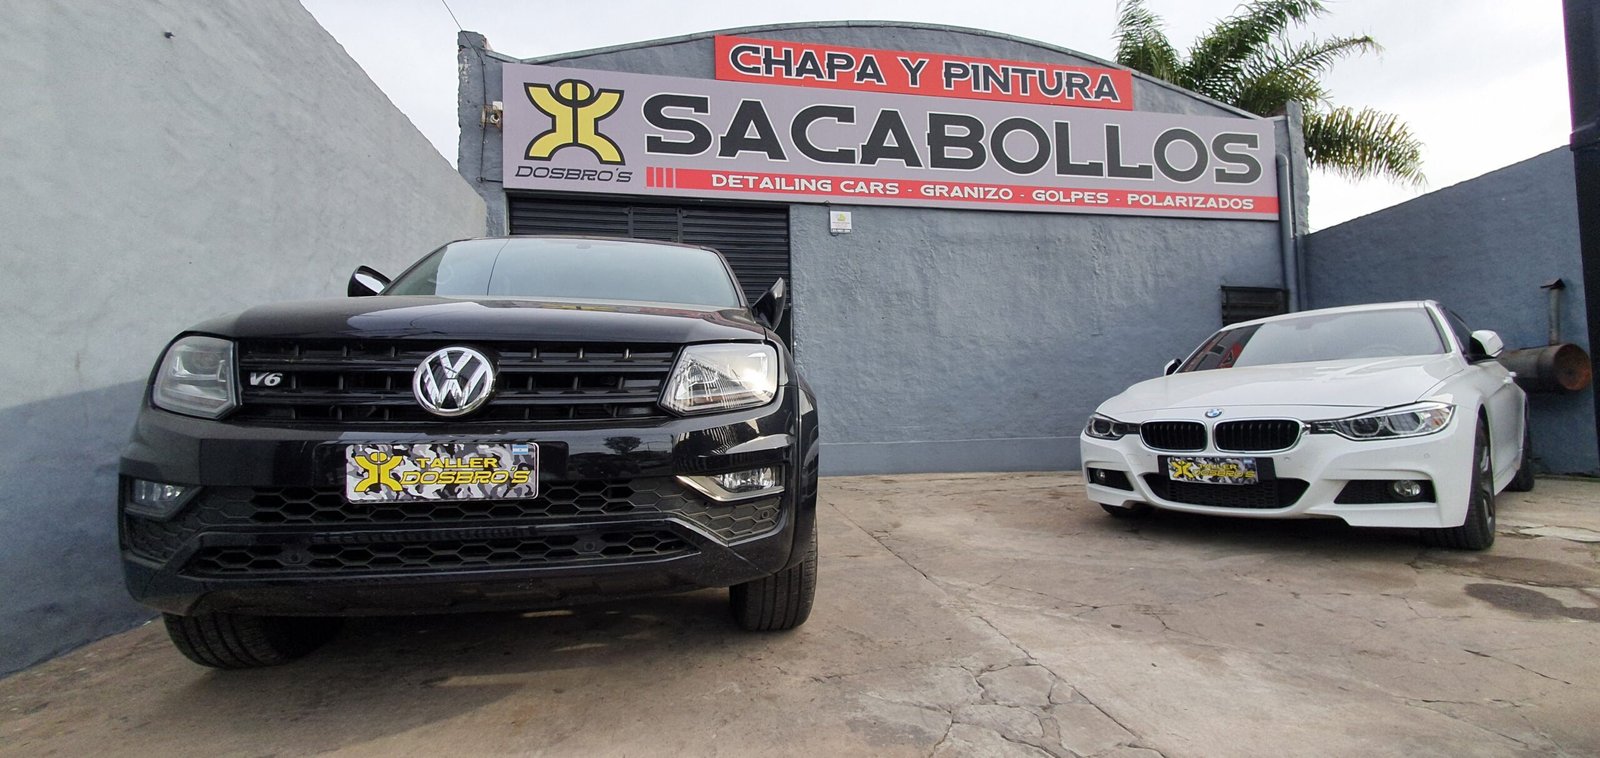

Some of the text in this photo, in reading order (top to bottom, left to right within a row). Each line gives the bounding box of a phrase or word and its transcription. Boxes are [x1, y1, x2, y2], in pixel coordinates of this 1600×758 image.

[729, 43, 1120, 103] CHAPA Y PINTURA
[642, 93, 1262, 186] SACABOLLOS
[711, 173, 832, 192] DETAILING
[839, 180, 899, 195] CARS
[920, 184, 1013, 200] GRANIZO
[1032, 189, 1109, 204] GOLPES
[1127, 193, 1254, 210] POLARIZADOS
[249, 371, 283, 387] V6
[416, 457, 498, 468] TALLER
